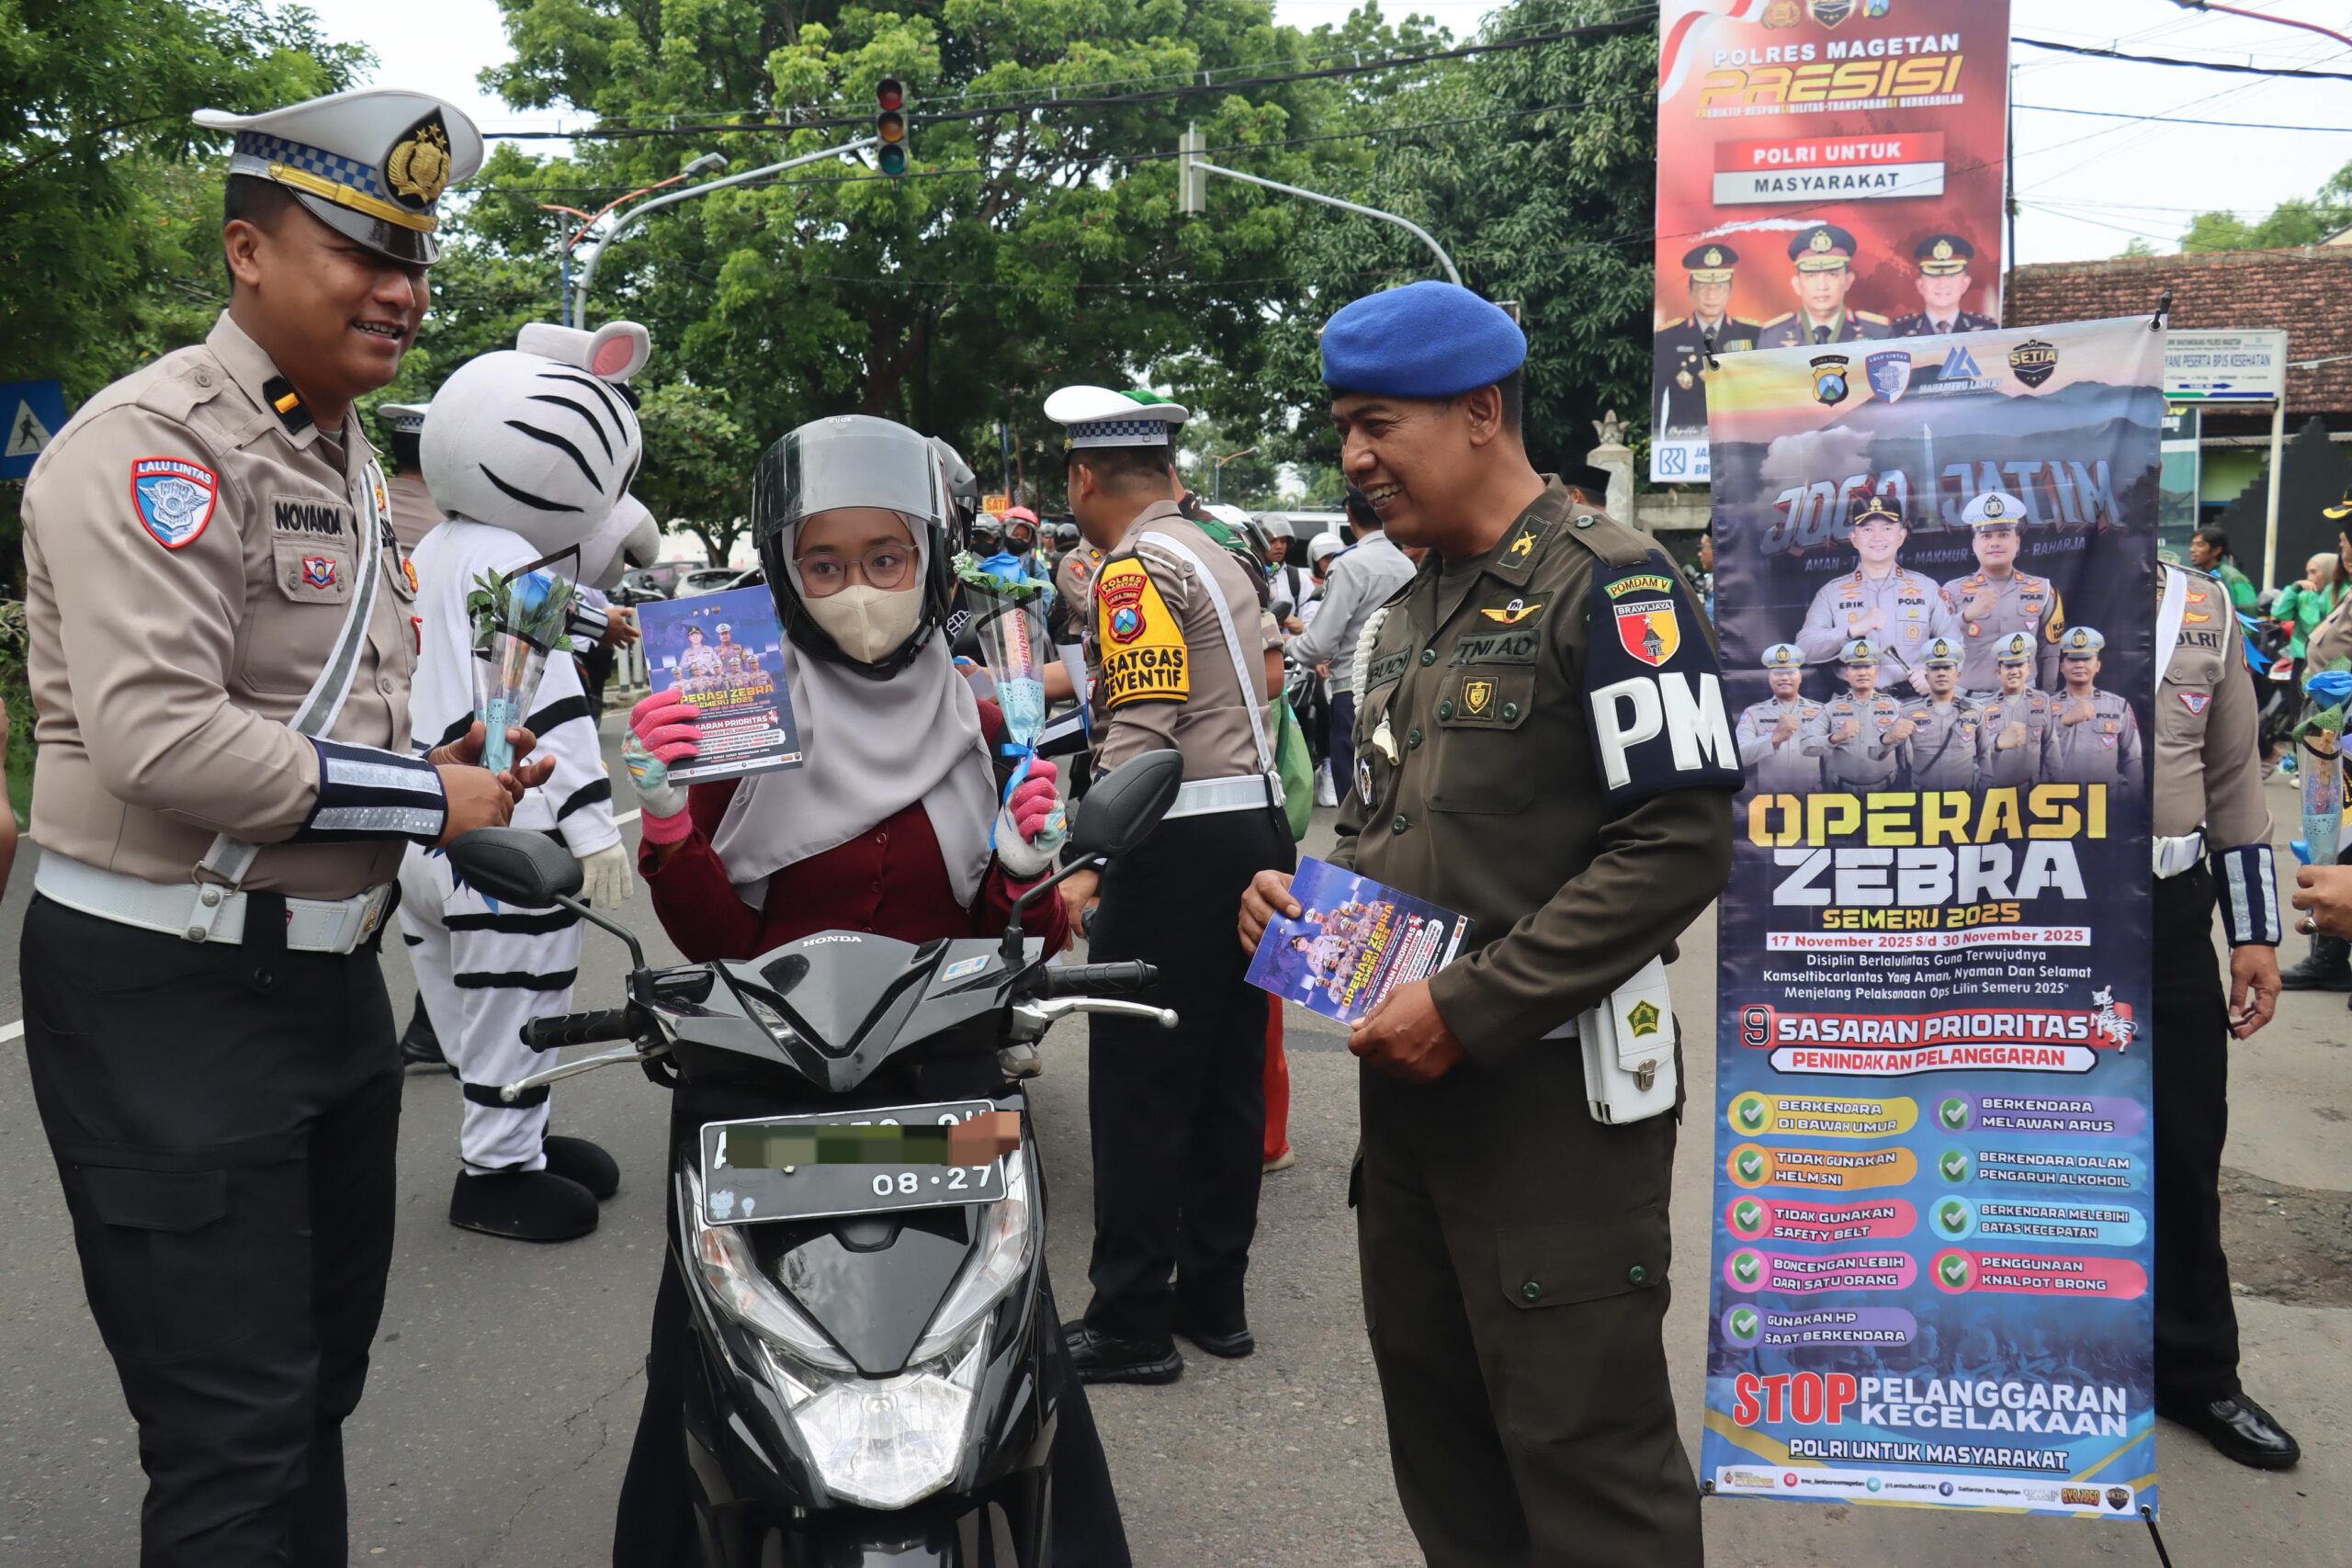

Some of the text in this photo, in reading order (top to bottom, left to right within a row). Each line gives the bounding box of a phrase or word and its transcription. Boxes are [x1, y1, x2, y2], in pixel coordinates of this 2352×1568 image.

[1713, 34, 1960, 67] POLRES MAGETAN
[1700, 55, 1964, 108] PRESISI
[1753, 141, 1902, 164] POLRI UNTUK
[1754, 173, 1900, 193] MASYARAKAT
[2009, 349, 2056, 366] SETIA
[2231, 354, 2271, 367] KESEHATAN
[1918, 381, 1967, 394] MAHAMERU
[138, 460, 212, 484] LALU LINTAS
[275, 502, 343, 535] NOVANDA
[1102, 575, 1142, 592] POLRES
[1610, 578, 1668, 595] POMDAM V
[1618, 603, 1670, 615] BRAWIJAYA
[730, 684, 774, 698] ZEBRA
[725, 716, 768, 728] PRIORITAS
[1590, 672, 1737, 790] PM
[1748, 784, 2107, 847] OPERASI
[1772, 840, 2087, 907] ZEBRA
[1823, 903, 2020, 930] SEMERU 2025
[802, 935, 862, 947] HONDA
[1392, 925, 1416, 970] PRIORITAS
[1771, 936, 1790, 947] 17
[1794, 935, 1874, 947] November
[1878, 936, 1913, 948] 2025
[1943, 934, 1959, 946] 30
[1962, 931, 2038, 944] November
[2044, 930, 2084, 942] 2025
[1340, 902, 1395, 1008] OPERASI ZEBRA
[1807, 950, 2046, 968] Disiplin Berlalulintas Guna Terwujudnya
[1359, 951, 1380, 988] SEMERU
[1763, 964, 2092, 985] Kamseltibcarlantas Yang Aman, Nyaman Dan Selamat
[1784, 986, 1851, 1000] Menjelang
[1855, 987, 1927, 999] Pelaksanaan
[1930, 986, 1949, 998] Ops
[1952, 983, 1977, 996] Lilin
[1982, 981, 2030, 994] Semeru
[1745, 1007, 2089, 1045] 9 SASARAN PRIORITAS
[1792, 1047, 2064, 1070] PENINDAKAN PELANGGARAN
[1778, 1100, 1883, 1116] BERKENDARA
[1982, 1098, 2093, 1113] BERKENDARA
[1778, 1117, 1897, 1133] DI BAWAH UMUR
[1982, 1116, 2114, 1133] MELAWAN ARUS
[1776, 1152, 1896, 1168] TIDAK GUNAKAN
[1979, 1151, 2130, 1169] BERKENDARA DALAM
[1775, 1170, 1843, 1186] HELM SNI
[1979, 1168, 2130, 1188] PENGARUH ALKOHOIL
[1774, 1207, 1894, 1224] TIDAK GUNAKAN
[1981, 1204, 2130, 1223] BERKENDARA MELEBIHI
[1773, 1225, 1871, 1241] SAFETY BELT
[1981, 1223, 2098, 1238] BATAS KECEPATAN
[1773, 1257, 1905, 1272] BONCENGAN LEBIH
[1982, 1257, 2084, 1272] PENGGUNAAN
[1772, 1273, 1897, 1290] DARI SATU ORANG
[1982, 1274, 2108, 1291] KNALPOT BRONG
[1767, 1312, 1858, 1327] GUNAKAN HP
[1764, 1329, 1906, 1345] SAAT BERKENDARA
[1733, 1371, 2127, 1427] STOP PELANGGARAN
[1860, 1402, 2127, 1438] KECELAKAAN
[1789, 1439, 2070, 1470] POLRI UNTUK MASYARAKAT
